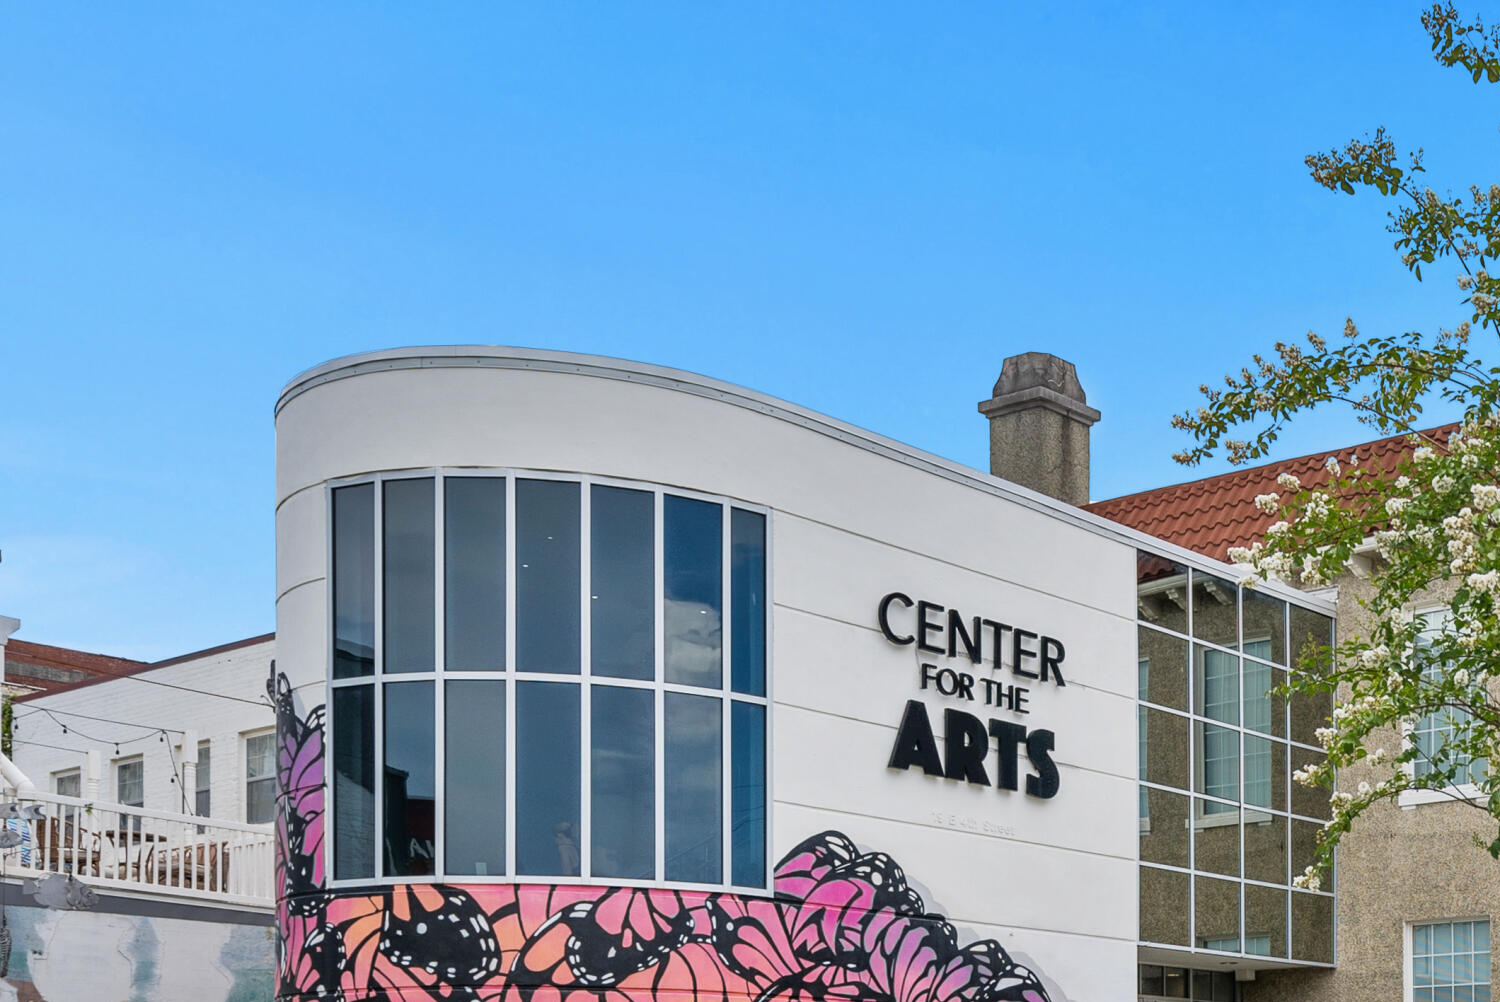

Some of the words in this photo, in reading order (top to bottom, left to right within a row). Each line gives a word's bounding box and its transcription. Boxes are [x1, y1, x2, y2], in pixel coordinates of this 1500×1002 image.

[878, 592, 1066, 687] CENTER
[920, 663, 974, 701] FOR
[980, 678, 1030, 714] THE
[887, 699, 1060, 800] ARTS
